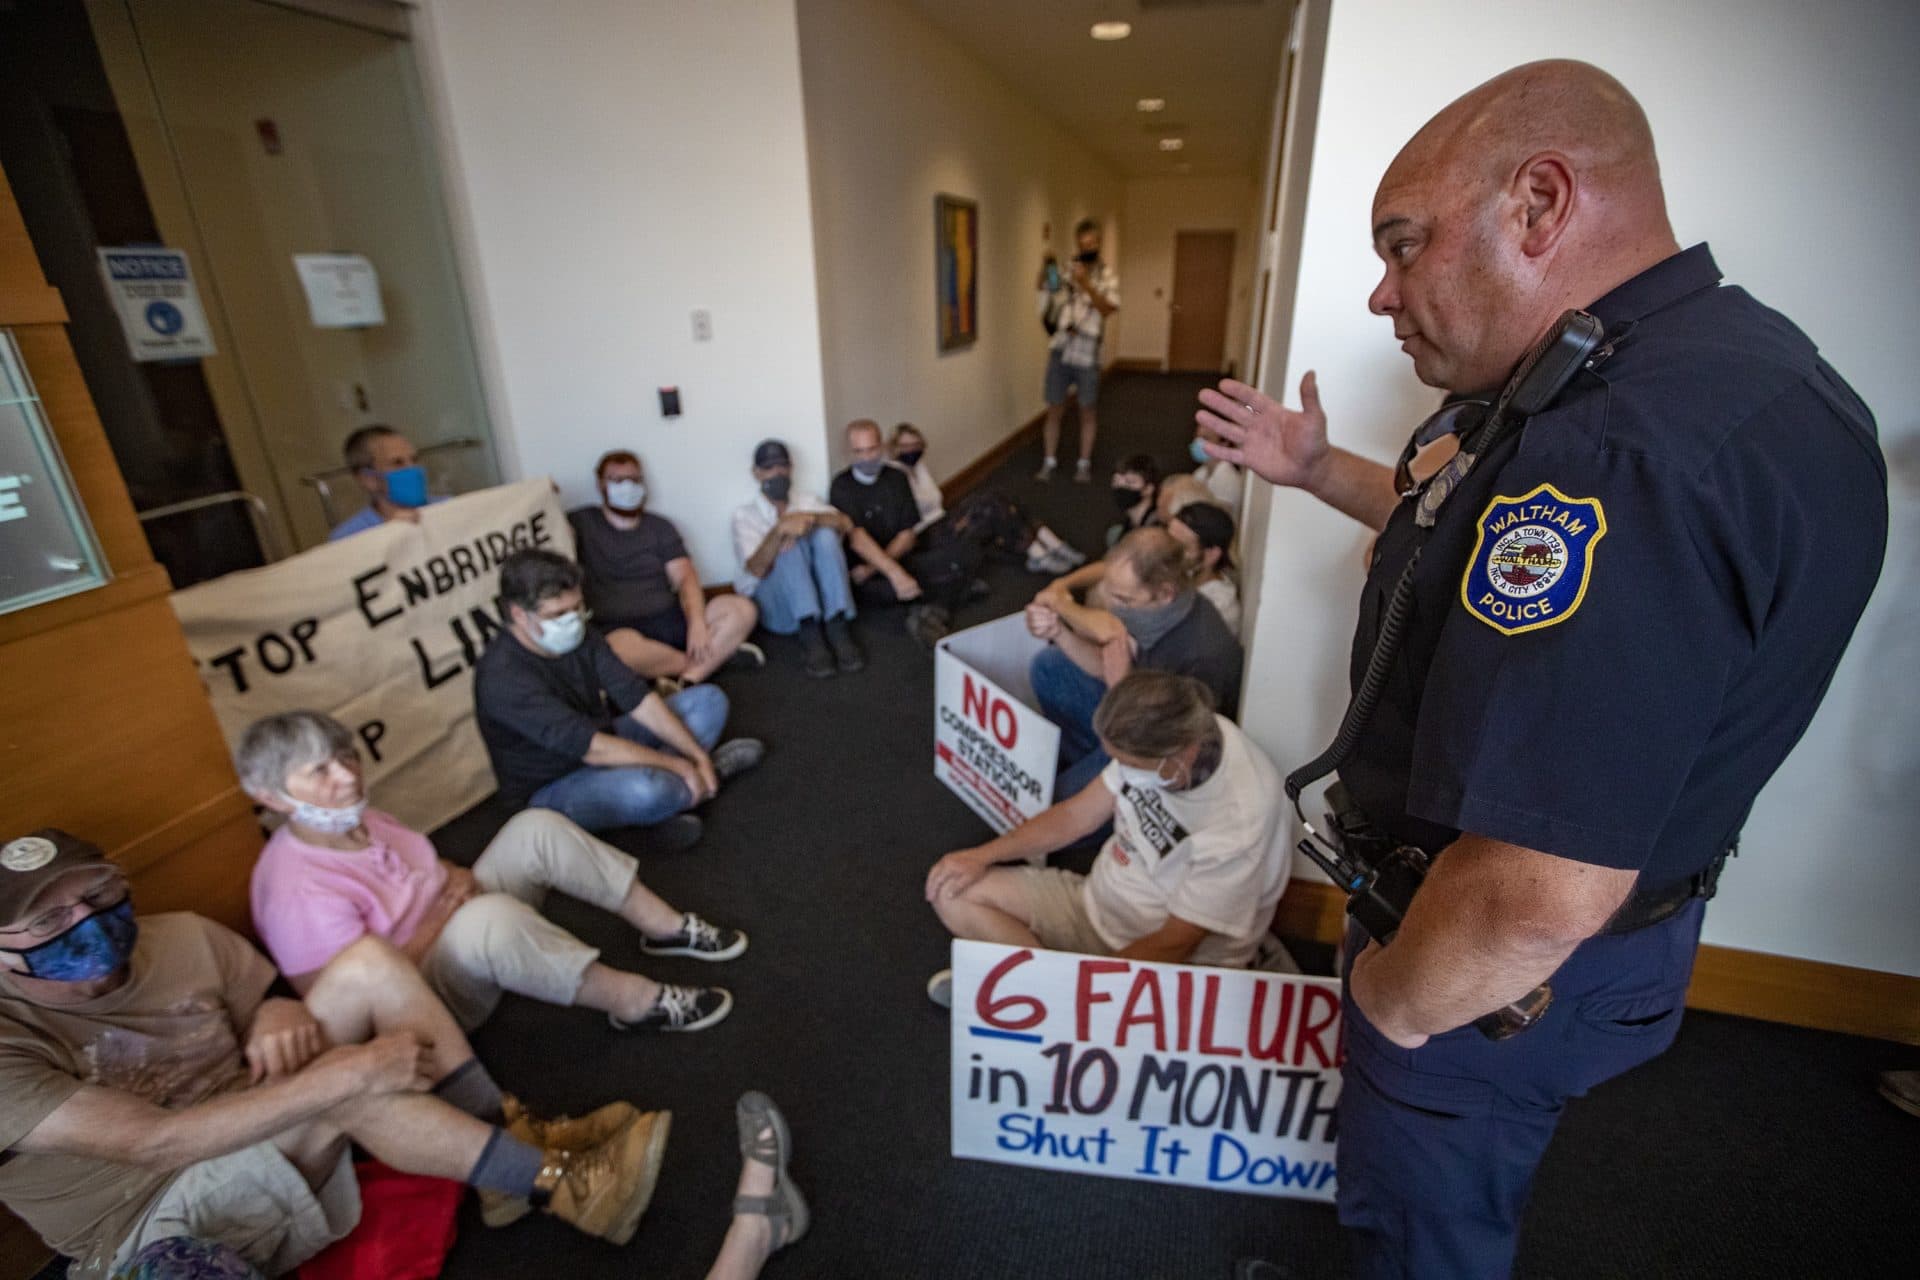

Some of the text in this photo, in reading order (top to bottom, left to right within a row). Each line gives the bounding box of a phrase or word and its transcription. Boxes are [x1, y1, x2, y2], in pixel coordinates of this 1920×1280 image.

[110, 257, 186, 279] NOTICE
[1489, 505, 1587, 536] WALTHAM
[1522, 528, 1548, 538] TOWN
[1547, 535, 1563, 554] 1738
[1501, 556, 1552, 566] WALTHAM
[1508, 585, 1529, 594] CITY
[1532, 571, 1556, 591] 1884
[193, 511, 551, 693] TOP ENBRIDGE
[1479, 592, 1553, 620] POLICE
[411, 595, 507, 689] LIN
[962, 672, 1018, 750] NO
[940, 705, 1042, 803] COMPRESSOR
[957, 738, 1019, 802] STATION
[975, 949, 1347, 1069] 6 FAILUR
[968, 1042, 1337, 1143] in 10 MONTH
[997, 1113, 1116, 1164] Shut
[1136, 1125, 1190, 1176] It
